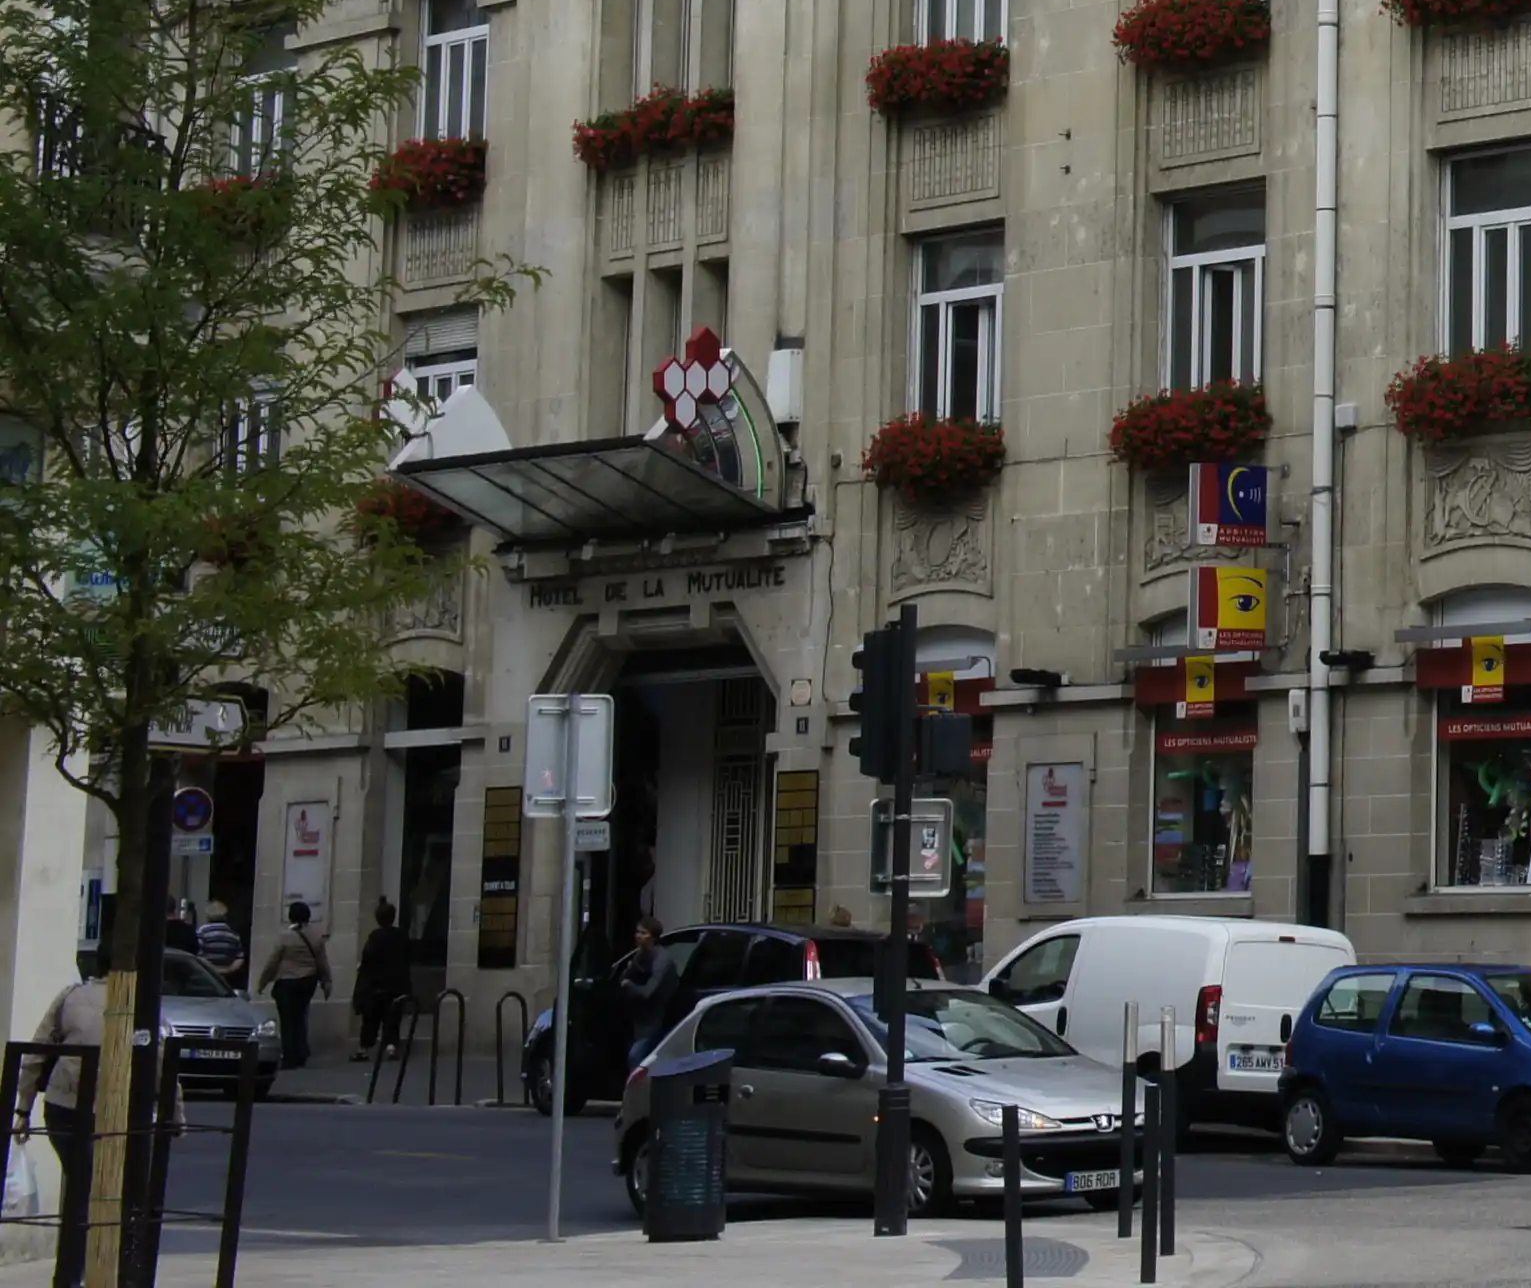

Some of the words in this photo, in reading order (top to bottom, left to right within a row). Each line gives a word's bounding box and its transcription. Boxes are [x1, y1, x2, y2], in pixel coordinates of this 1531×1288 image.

[530, 584, 584, 608] HOTEL
[605, 581, 628, 603] DE
[643, 578, 664, 598] LA
[1448, 724, 1462, 733] LES
[1463, 723, 1501, 732] OPTICIENS
[1164, 739, 1176, 748] LES
[1177, 737, 1211, 747] OPTICIENS
[1236, 1056, 1254, 1070] 265
[1073, 1174, 1093, 1189] 806
